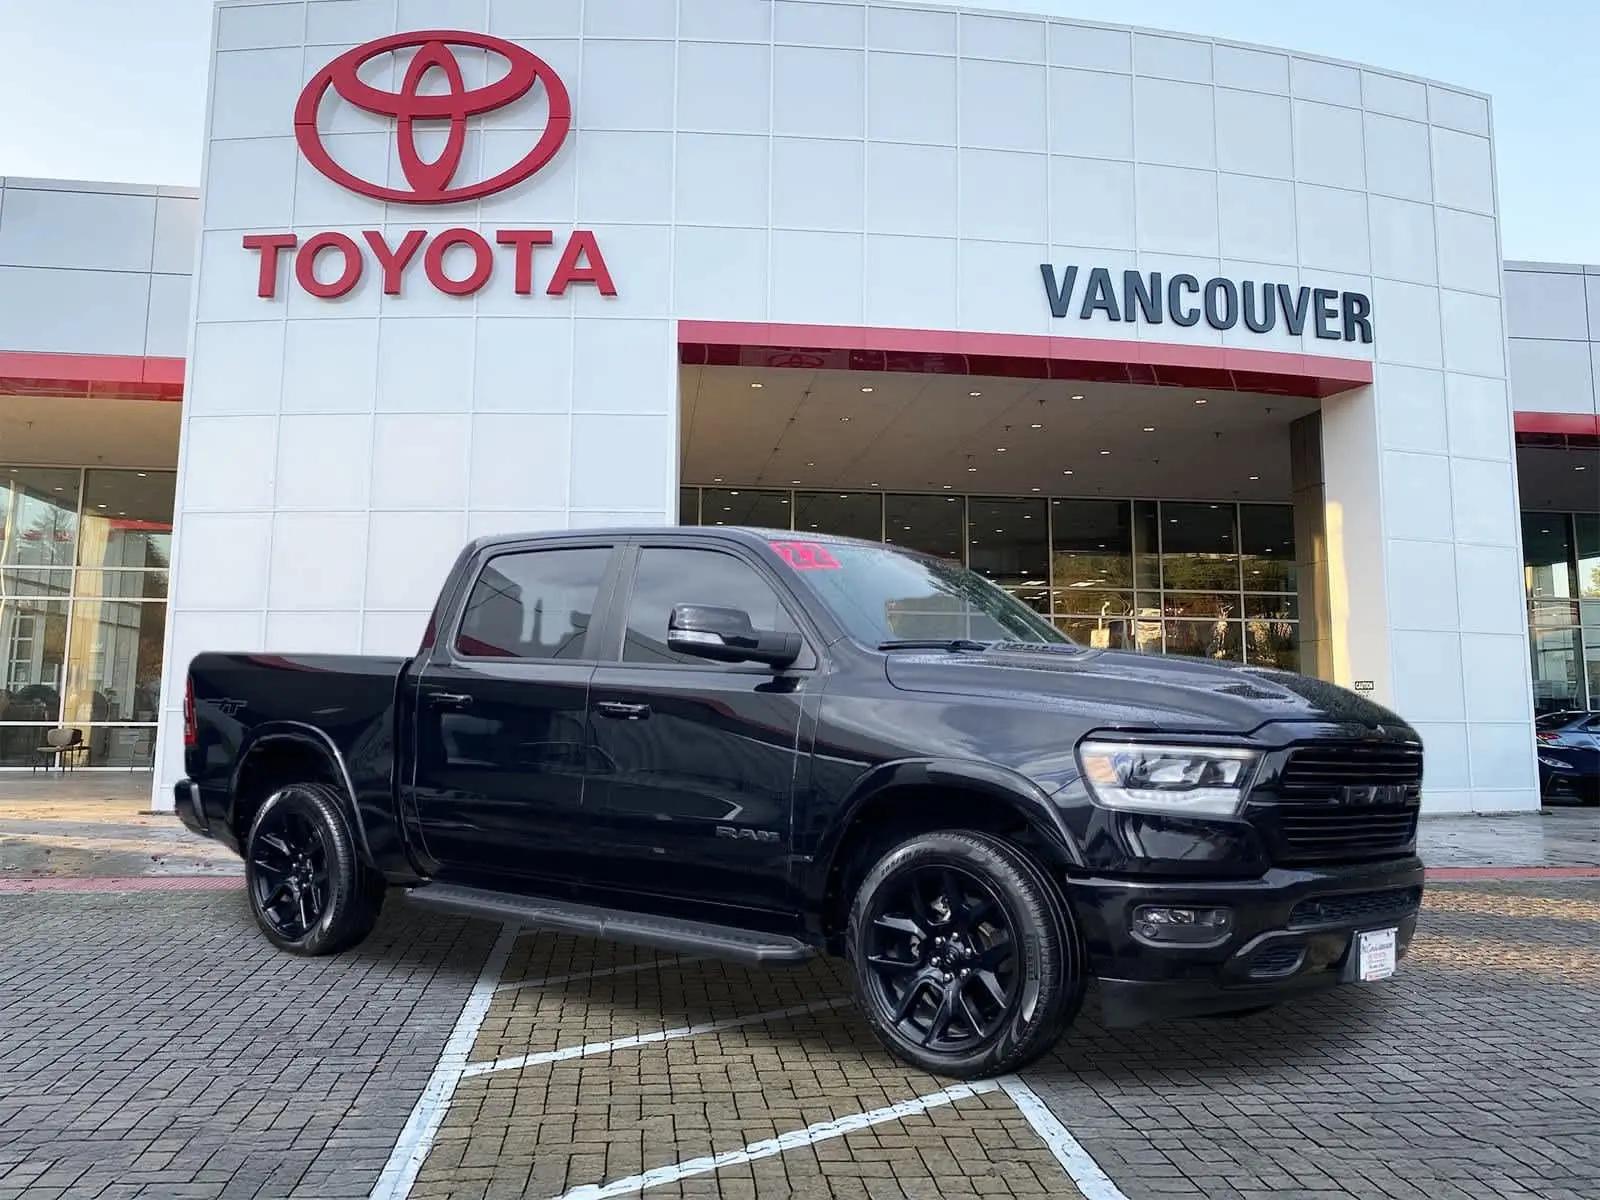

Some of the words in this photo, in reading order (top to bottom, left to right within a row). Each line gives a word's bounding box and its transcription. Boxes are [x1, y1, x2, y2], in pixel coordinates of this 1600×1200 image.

[243, 228, 617, 298] TOYOTA
[1040, 264, 1373, 343] VANCOUVER
[716, 825, 780, 842] RAM
